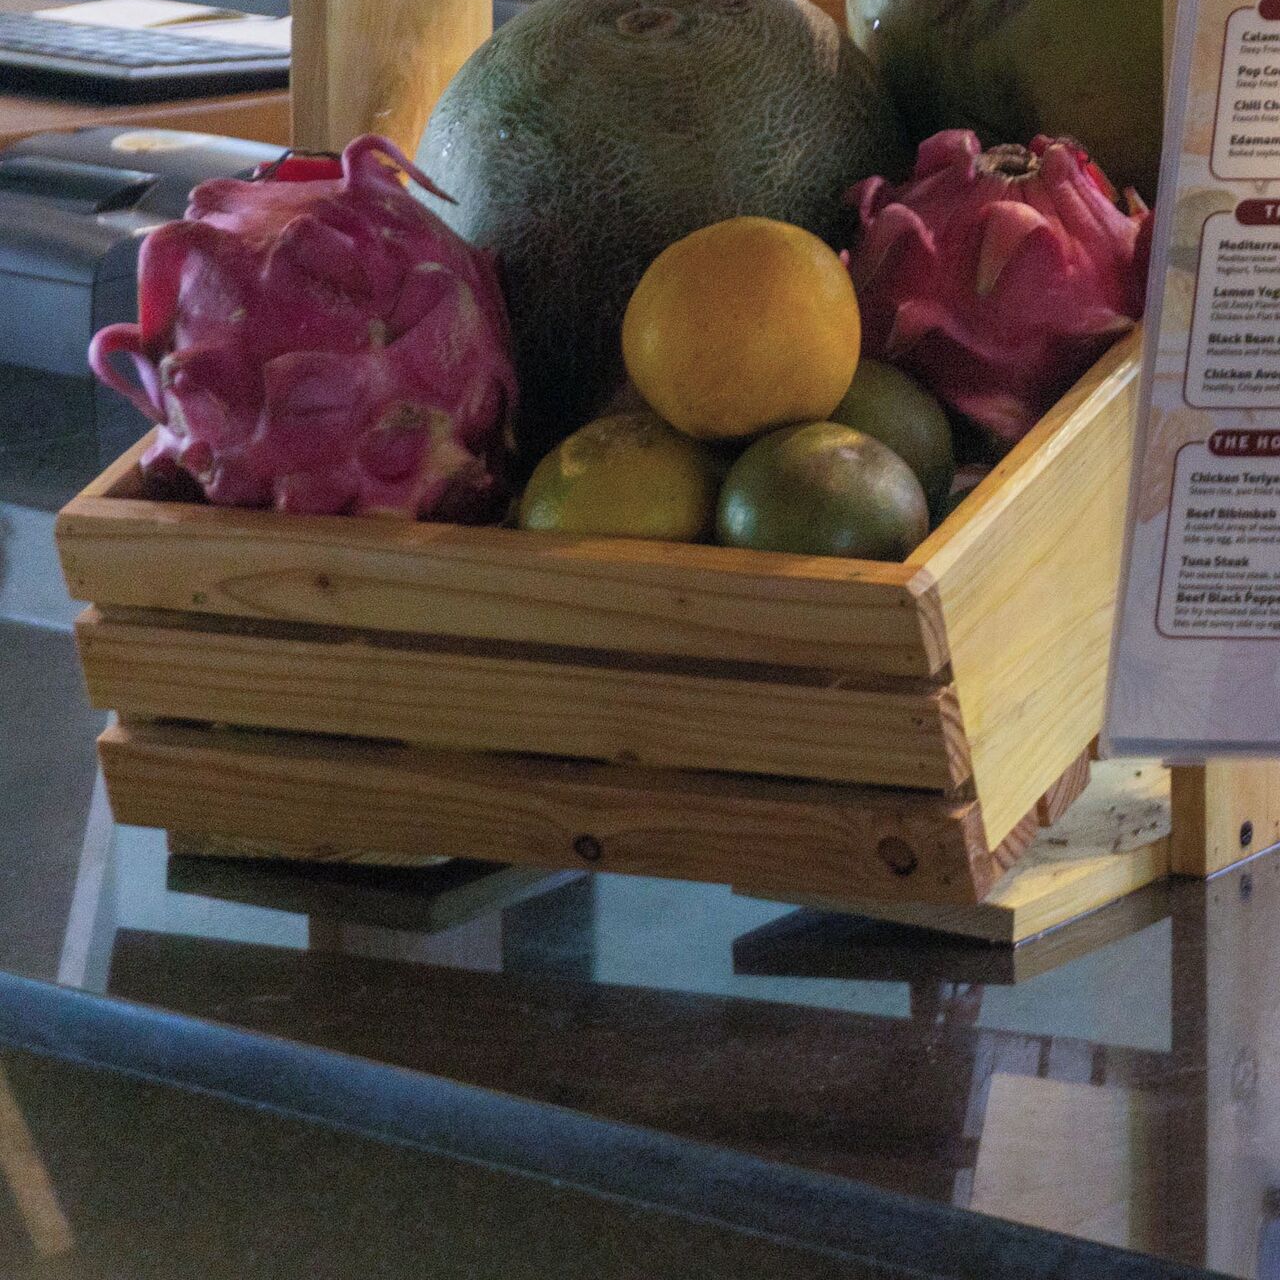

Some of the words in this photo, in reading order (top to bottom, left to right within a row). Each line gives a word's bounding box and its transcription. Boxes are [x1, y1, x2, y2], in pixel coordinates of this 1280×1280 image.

[1238, 65, 1258, 78] Pop
[1234, 100, 1261, 110] Chili
[1213, 287, 1255, 297] Lemon
[1214, 436, 1248, 449] THE
[1191, 472, 1239, 483] Chicken
